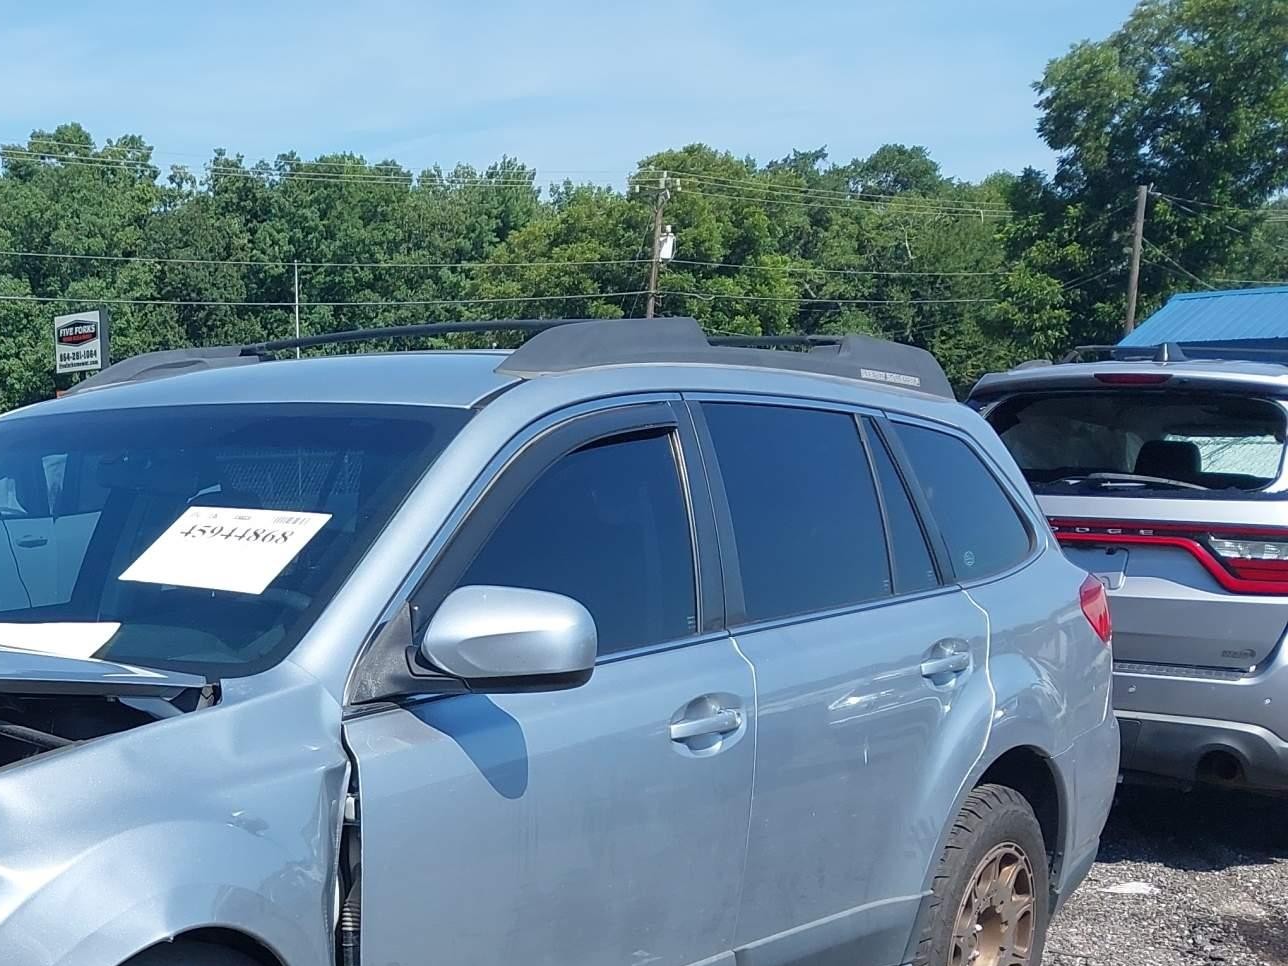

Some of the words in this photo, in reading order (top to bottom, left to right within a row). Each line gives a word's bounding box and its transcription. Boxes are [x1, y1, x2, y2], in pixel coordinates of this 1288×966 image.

[59, 327, 74, 337] FIVE
[74, 324, 96, 335] FORKS
[180, 524, 295, 544] 45944868
